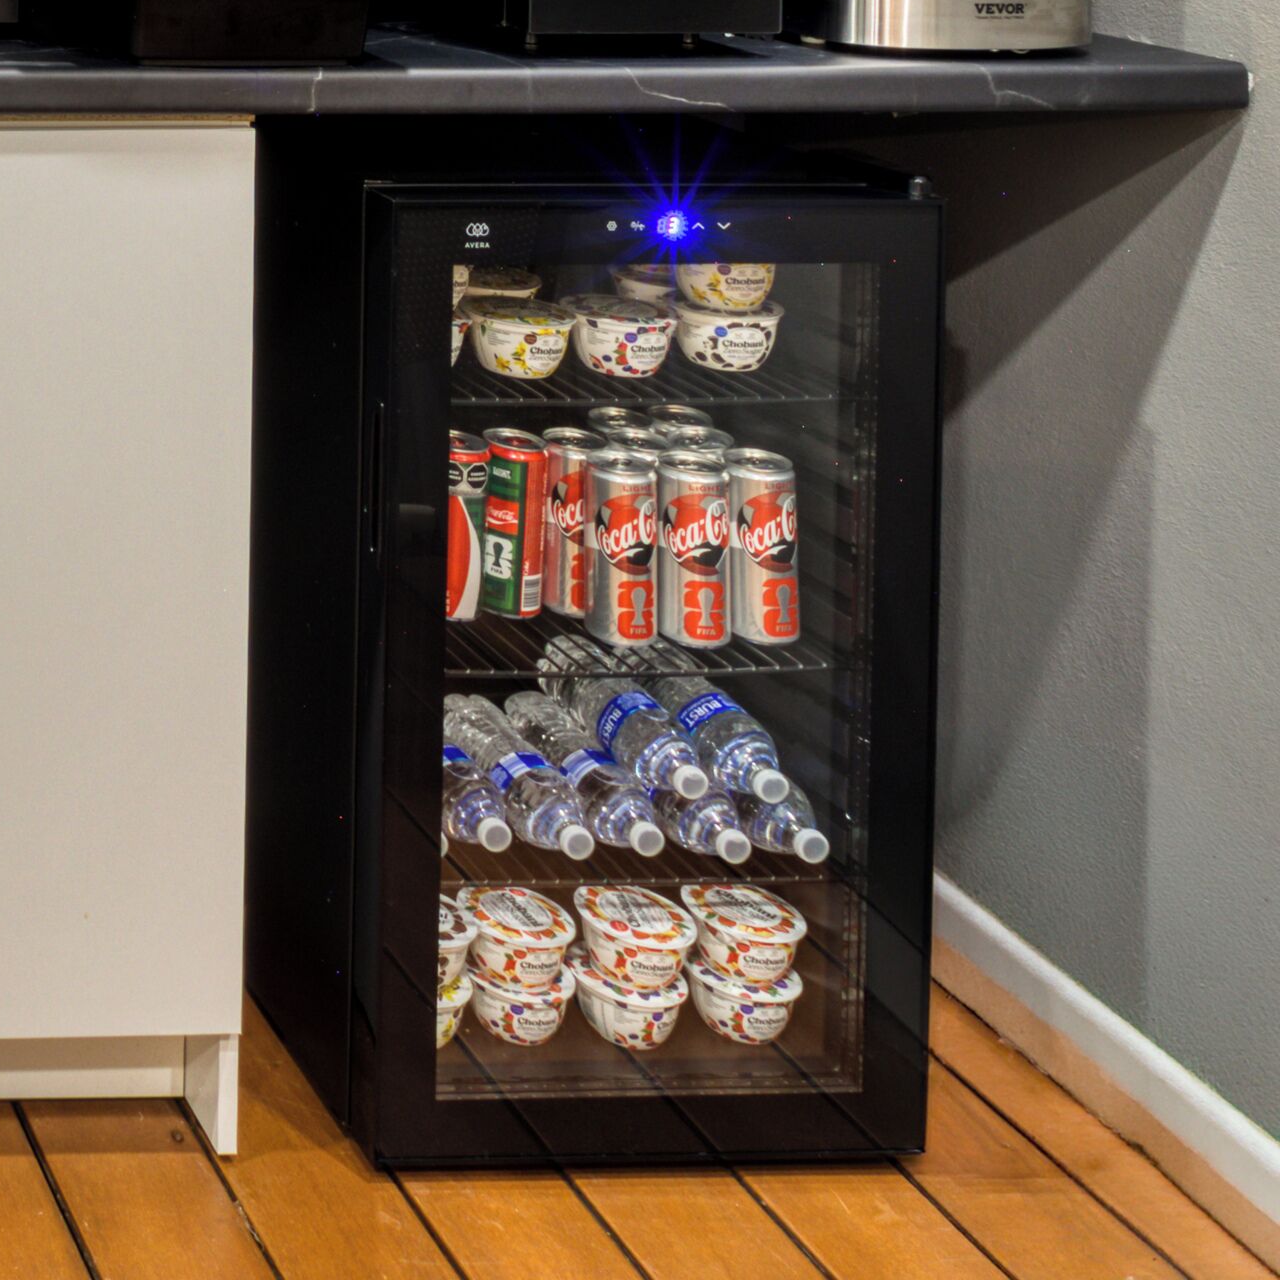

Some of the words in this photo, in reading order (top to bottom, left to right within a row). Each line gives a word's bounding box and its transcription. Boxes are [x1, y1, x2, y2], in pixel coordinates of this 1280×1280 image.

[974, 2, 1025, 15] VEVOR
[464, 241, 490, 249] AVERA
[725, 277, 765, 286] Chobani
[722, 339, 764, 349] Chobani
[696, 627, 716, 636] FIFA
[685, 699, 723, 728] BURST
[520, 960, 559, 970] Chobani
[630, 960, 674, 971] Chobani
[743, 955, 786, 966] Chobani
